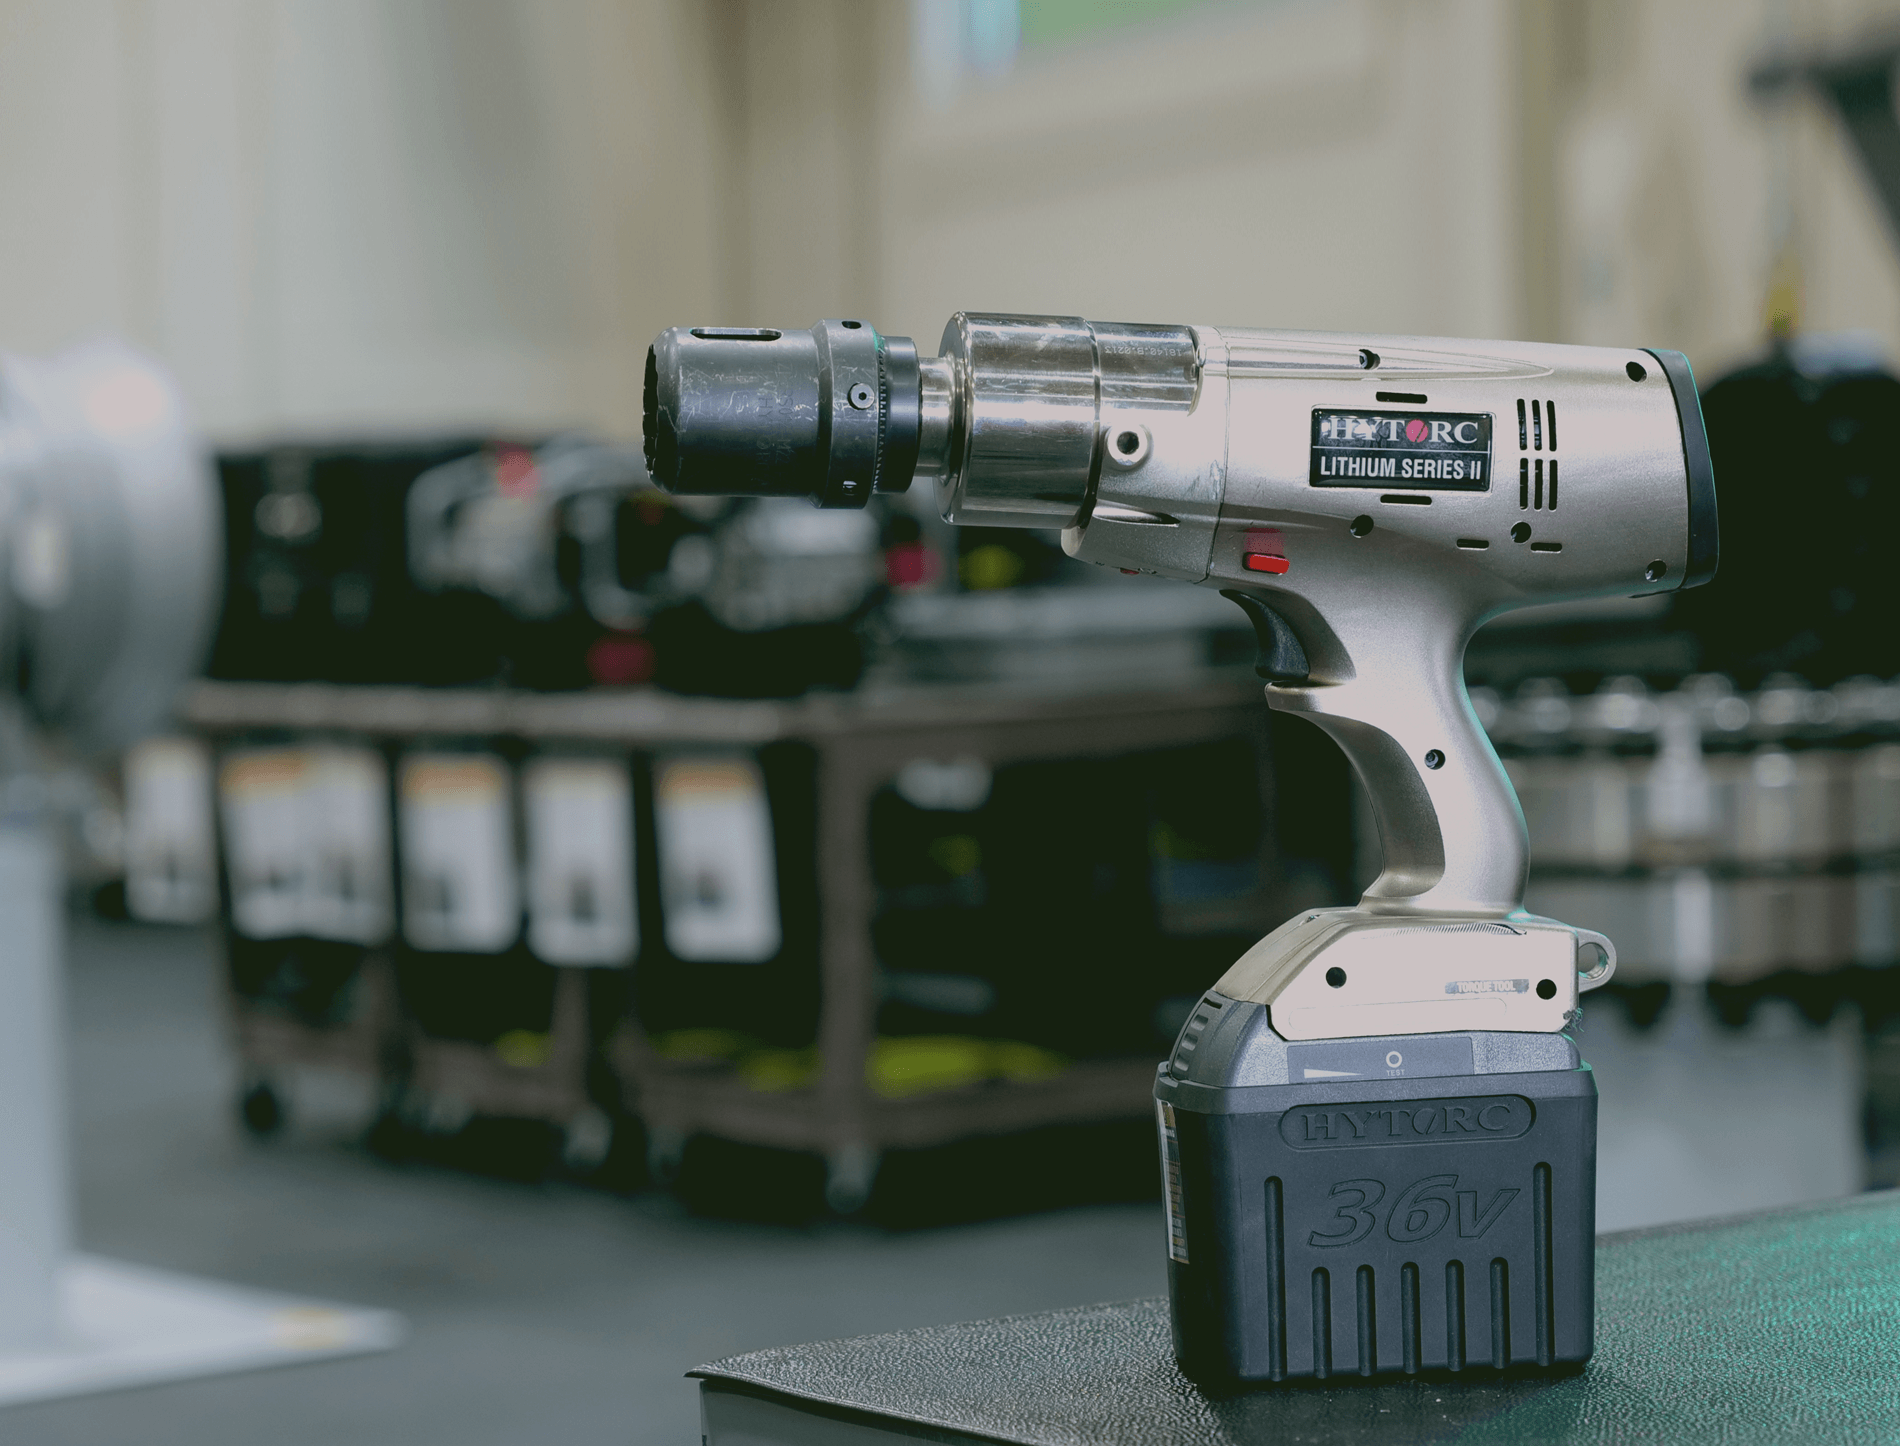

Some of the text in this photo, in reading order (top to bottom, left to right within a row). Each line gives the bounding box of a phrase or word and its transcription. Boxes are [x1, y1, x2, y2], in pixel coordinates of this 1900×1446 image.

[1328, 418, 1478, 443] HYTORC
[1320, 456, 1481, 480] LITHIUM SERIES II
[1457, 980, 1516, 993] TORQUE TOOL
[1386, 1069, 1405, 1077] TEST
[1301, 1104, 1511, 1140] HYTORC
